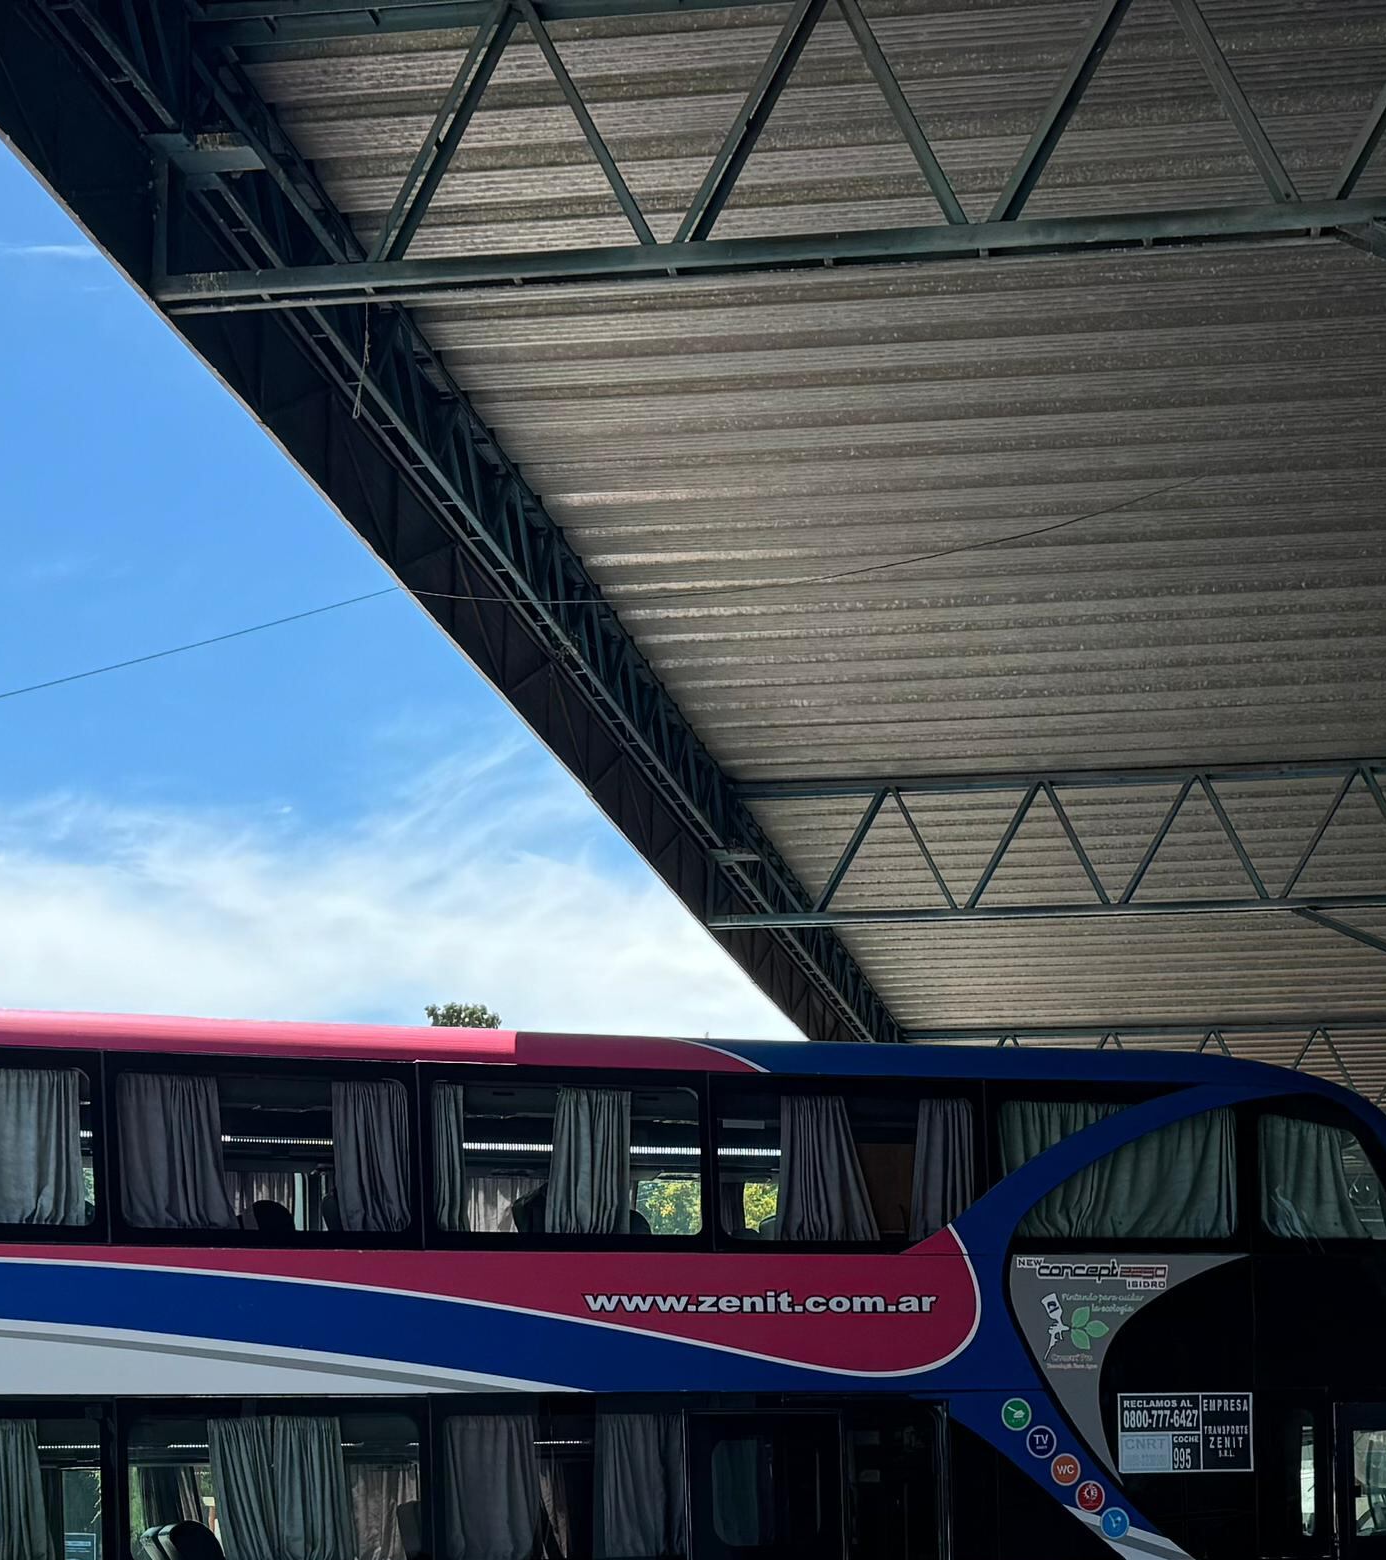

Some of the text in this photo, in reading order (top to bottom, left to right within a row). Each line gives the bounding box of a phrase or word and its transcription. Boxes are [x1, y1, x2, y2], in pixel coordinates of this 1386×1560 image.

[1017, 1256, 1044, 1267] NEW
[1037, 1259, 1119, 1283] concept
[1127, 1280, 1167, 1289] ISIDRO
[581, 1290, 937, 1313] www.zenit.com.ar
[1123, 1400, 1193, 1408] RECLAMOS AL
[1203, 1399, 1249, 1412] EMPRESA
[1123, 1410, 1199, 1428] 0800-777-6427
[1204, 1425, 1249, 1435] TRANSPORTE
[1033, 1434, 1049, 1445] TV
[1124, 1438, 1166, 1450] CNRT
[1173, 1435, 1200, 1443] COCHE
[1209, 1437, 1244, 1449] ZENIT
[1173, 1448, 1192, 1469] 995
[1057, 1464, 1075, 1475] WC
